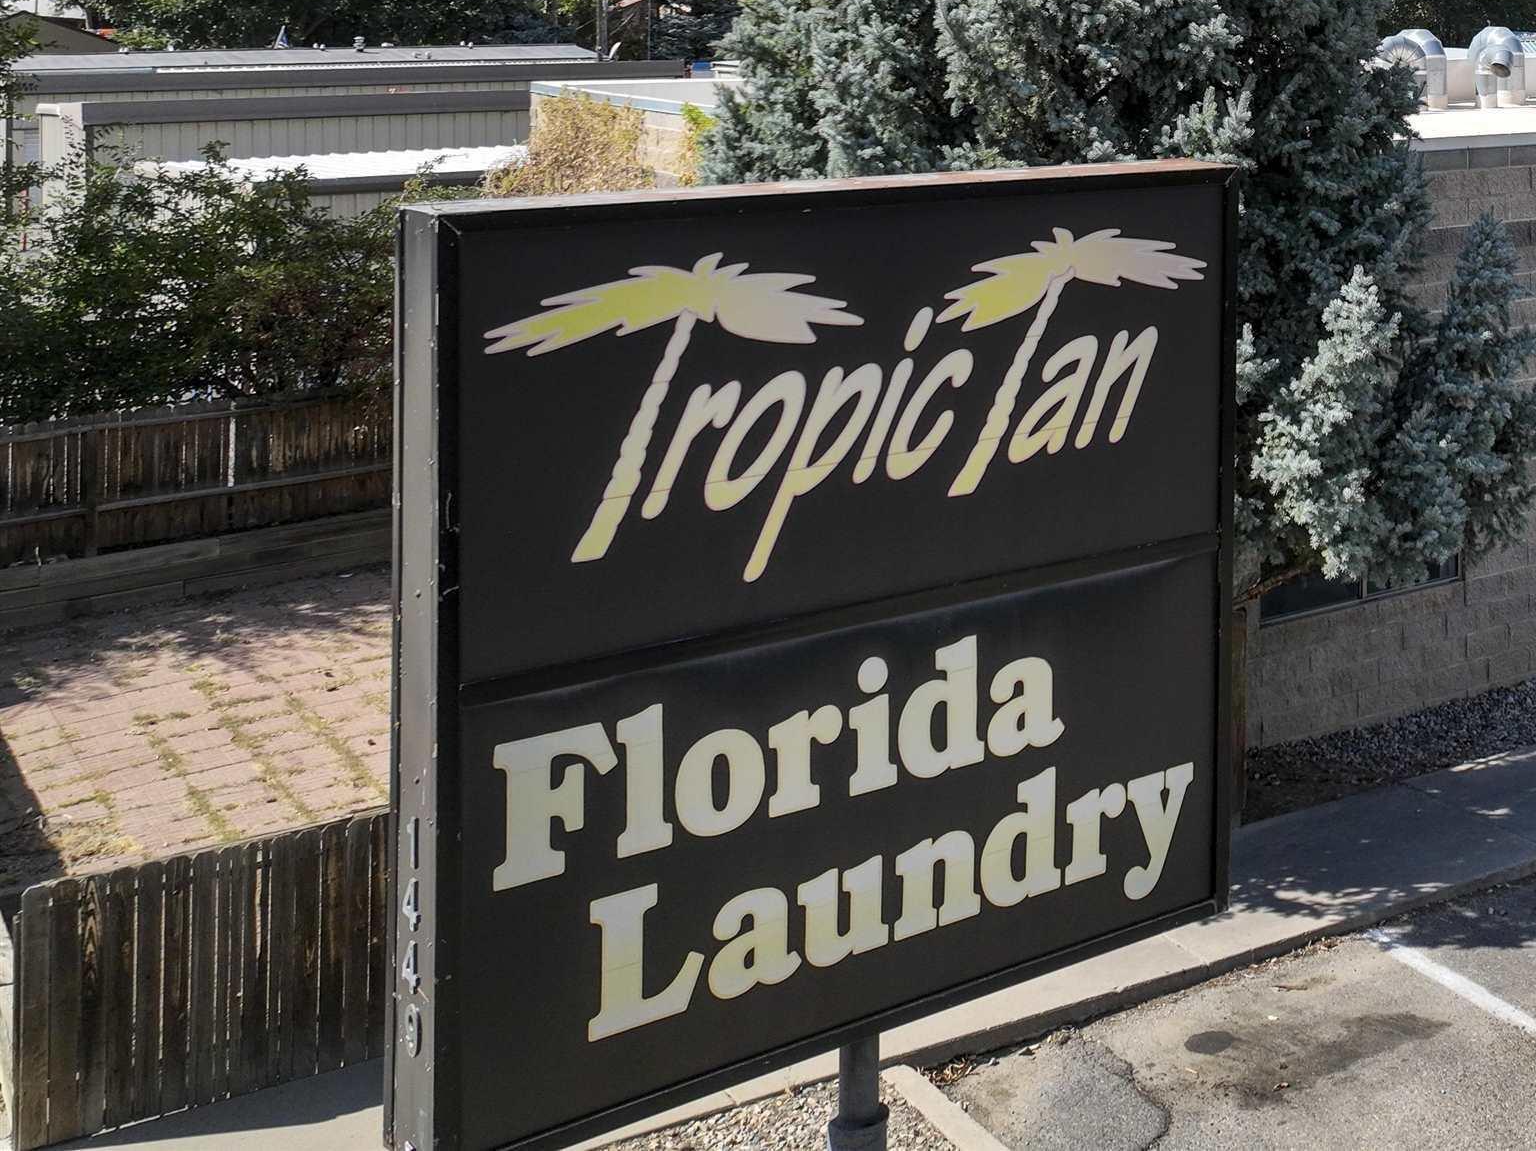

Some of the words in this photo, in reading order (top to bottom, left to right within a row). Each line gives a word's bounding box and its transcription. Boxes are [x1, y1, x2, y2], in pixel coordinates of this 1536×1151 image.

[484, 250, 974, 583] Tropic
[936, 226, 1206, 497] Tan
[492, 634, 1065, 892] Florida
[402, 816, 422, 1058] 1449
[587, 762, 1194, 1042] Laundry
